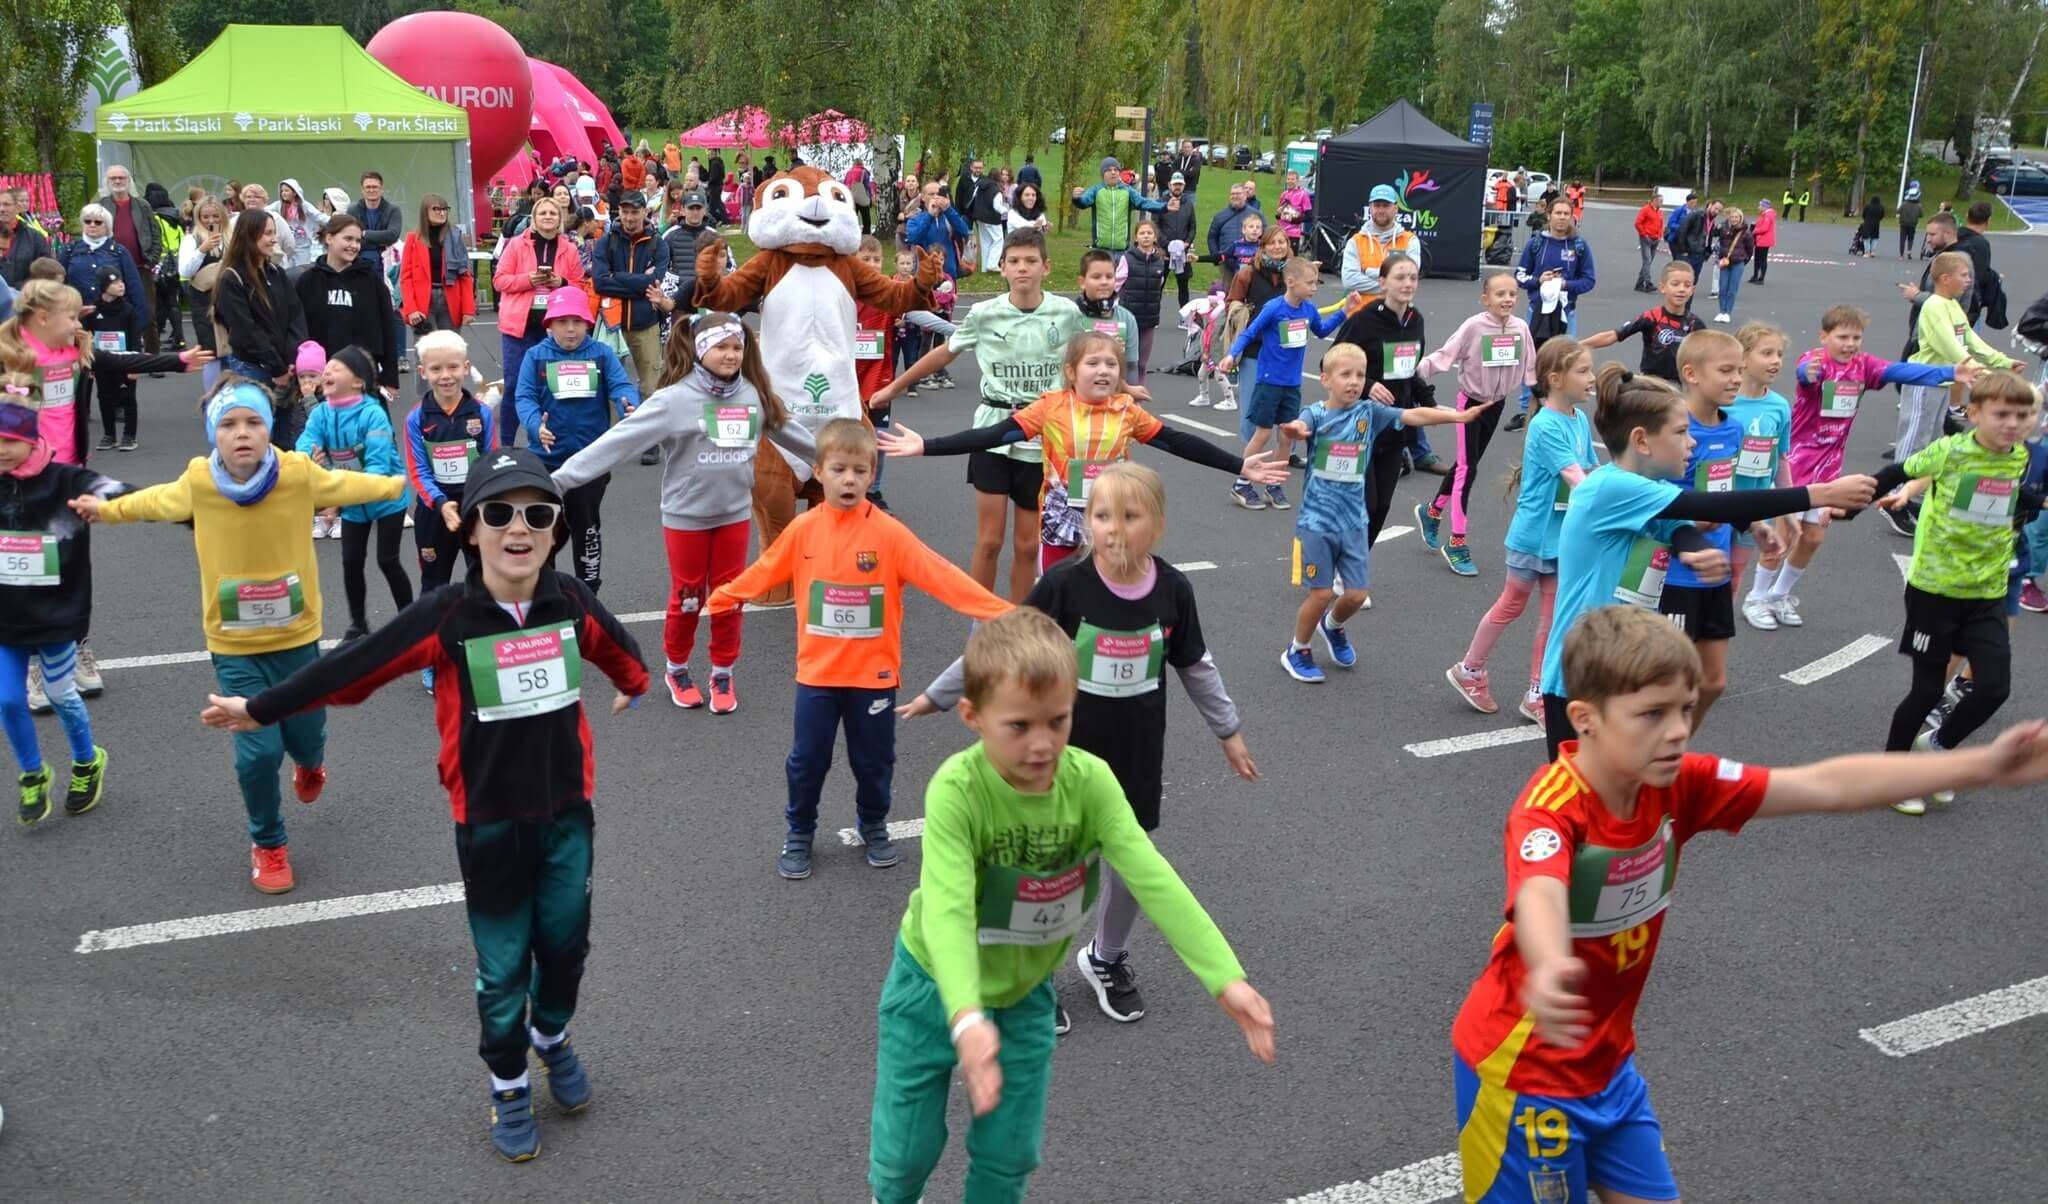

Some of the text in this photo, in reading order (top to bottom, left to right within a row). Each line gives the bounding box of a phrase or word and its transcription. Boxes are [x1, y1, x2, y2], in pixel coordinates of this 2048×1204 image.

[134, 114, 222, 134] Park Śląski
[258, 114, 342, 134] Park Śląski
[378, 114, 458, 134] Park Śląski
[858, 342, 870, 352] 27
[1498, 349, 1511, 358] 64
[992, 361, 1063, 378] Emirates
[54, 383, 67, 395] 16
[565, 377, 582, 387] 46
[726, 423, 742, 435] 62
[697, 447, 750, 464] adidas
[1752, 455, 1760, 465] 4
[442, 461, 458, 473] 15
[7, 556, 30, 571] 56
[252, 602, 276, 617] 55
[833, 608, 856, 624] 66
[1110, 662, 1134, 680] 18
[517, 667, 550, 693] 58
[1619, 880, 1648, 910] 75
[1032, 902, 1065, 925] 42
[1610, 923, 1650, 974] 19
[1514, 1105, 1570, 1158] 19
